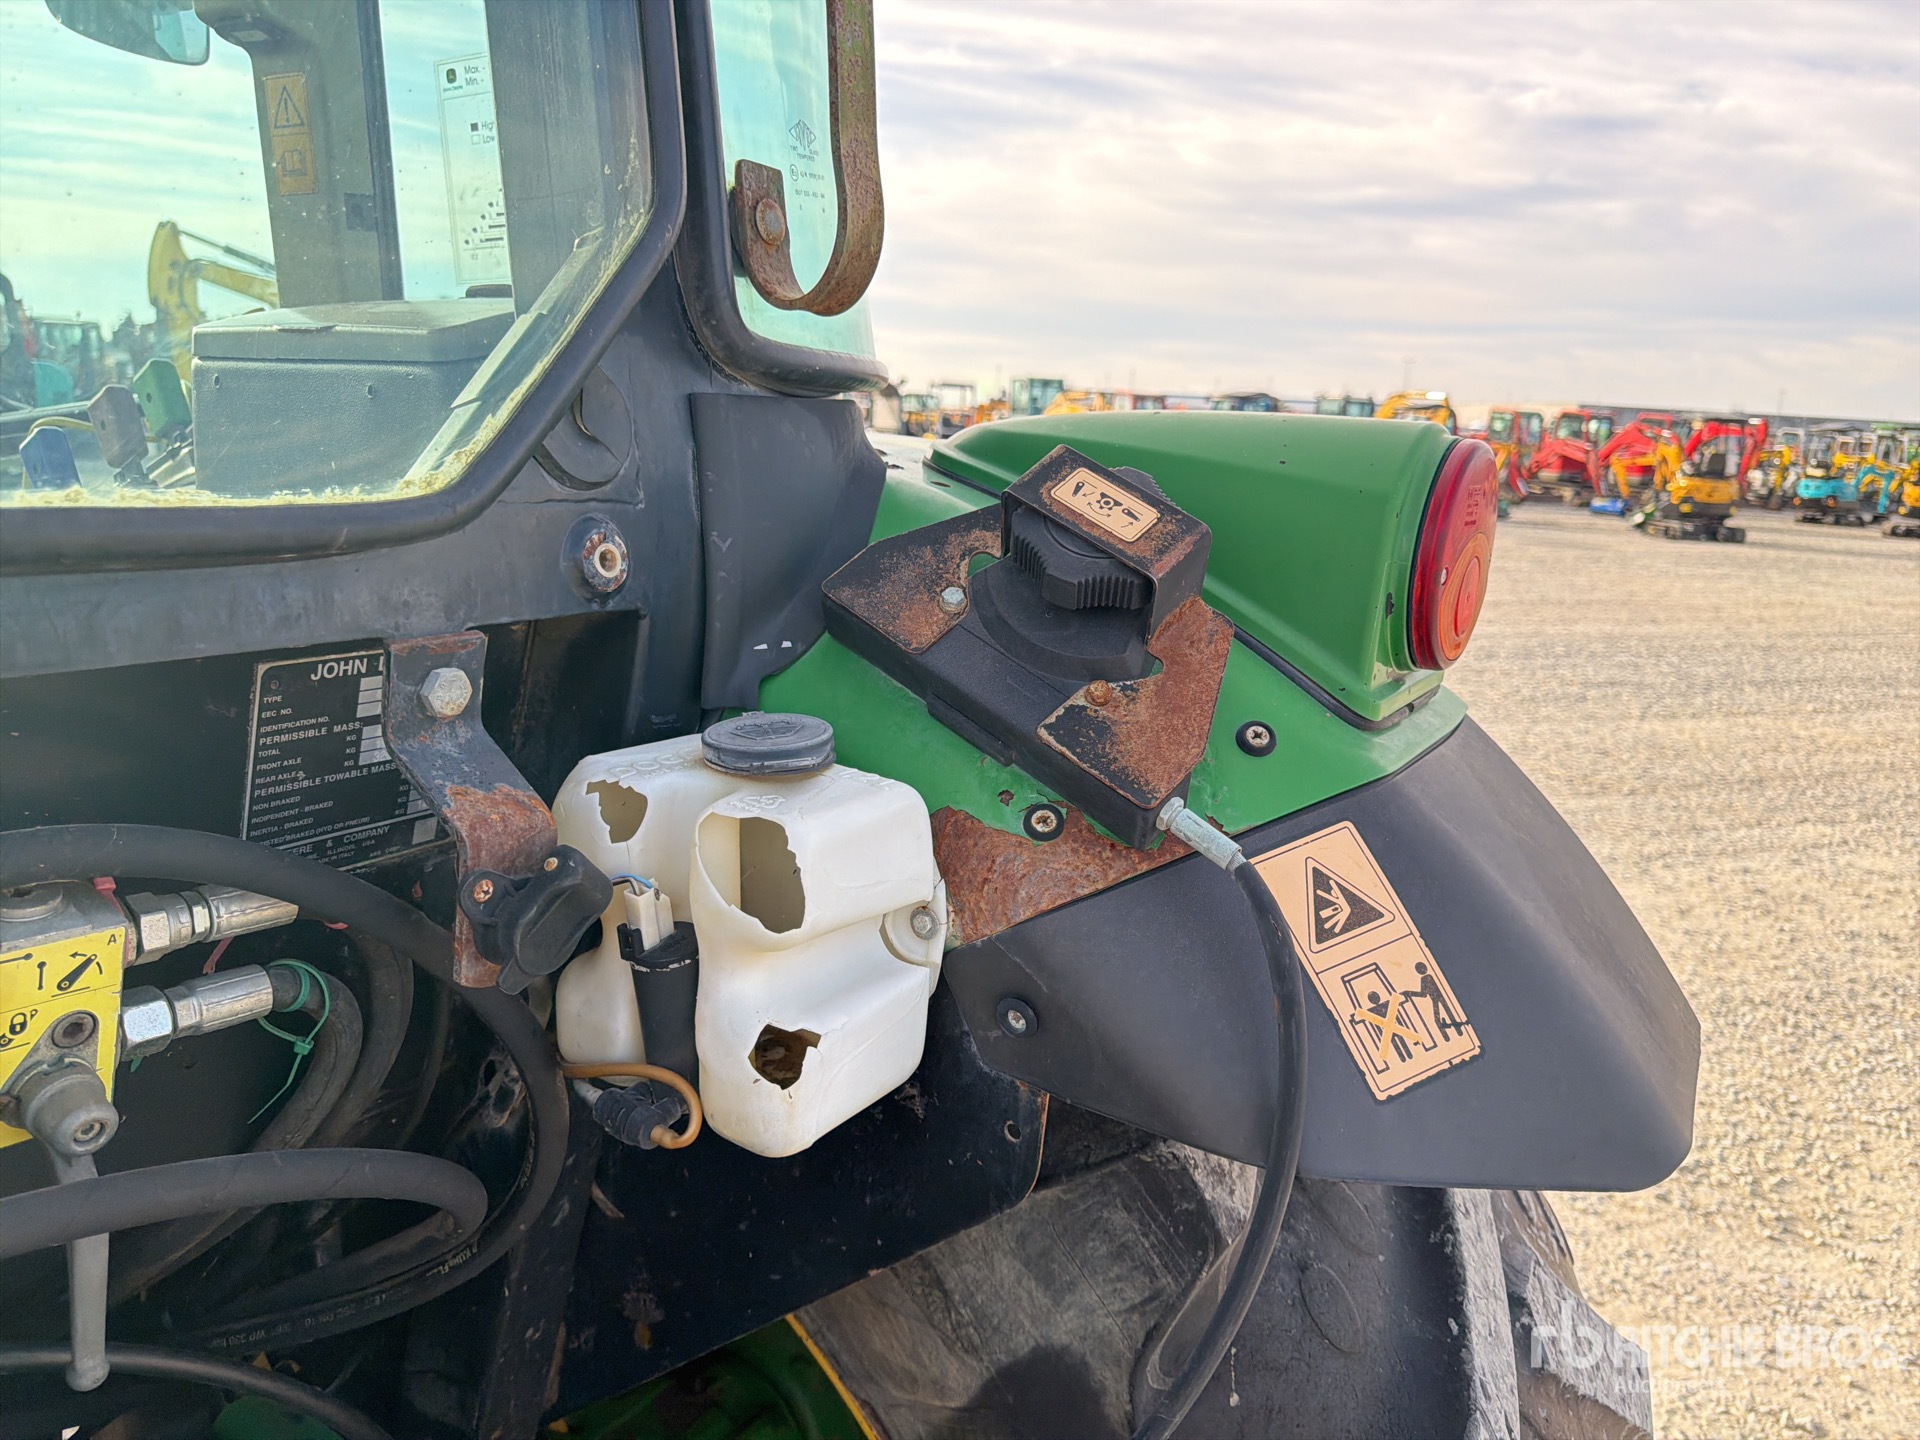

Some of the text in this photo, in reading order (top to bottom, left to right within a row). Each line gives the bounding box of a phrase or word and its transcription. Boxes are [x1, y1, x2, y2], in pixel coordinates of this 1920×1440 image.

[311, 658, 368, 680] JOHN
[263, 696, 282, 704] TYPE
[262, 708, 293, 718] EEC NO.
[260, 718, 317, 733] IDENTIFICATION
[260, 721, 364, 746] PERMISSIBLE MASS:
[346, 734, 357, 742] KG
[258, 748, 280, 758] TOTAL
[256, 760, 282, 772] FRONT
[282, 757, 302, 767] AXLE
[254, 777, 322, 798] PERMISSIBLE
[324, 768, 368, 784] TOWABLE
[255, 770, 297, 785] REAR AXLE
[252, 803, 268, 812] NON
[270, 796, 301, 808] BRAKED
[251, 808, 300, 824] INDIPENDENT
[304, 800, 334, 812] BRAKED
[250, 826, 278, 837] INERTIA
[284, 818, 314, 830] BRAKED
[285, 829, 315, 840] BRAKED
[334, 822, 344, 830] OR
[326, 840, 333, 848] &
[344, 826, 390, 843] COMPANY
[106, 934, 117, 946] A
